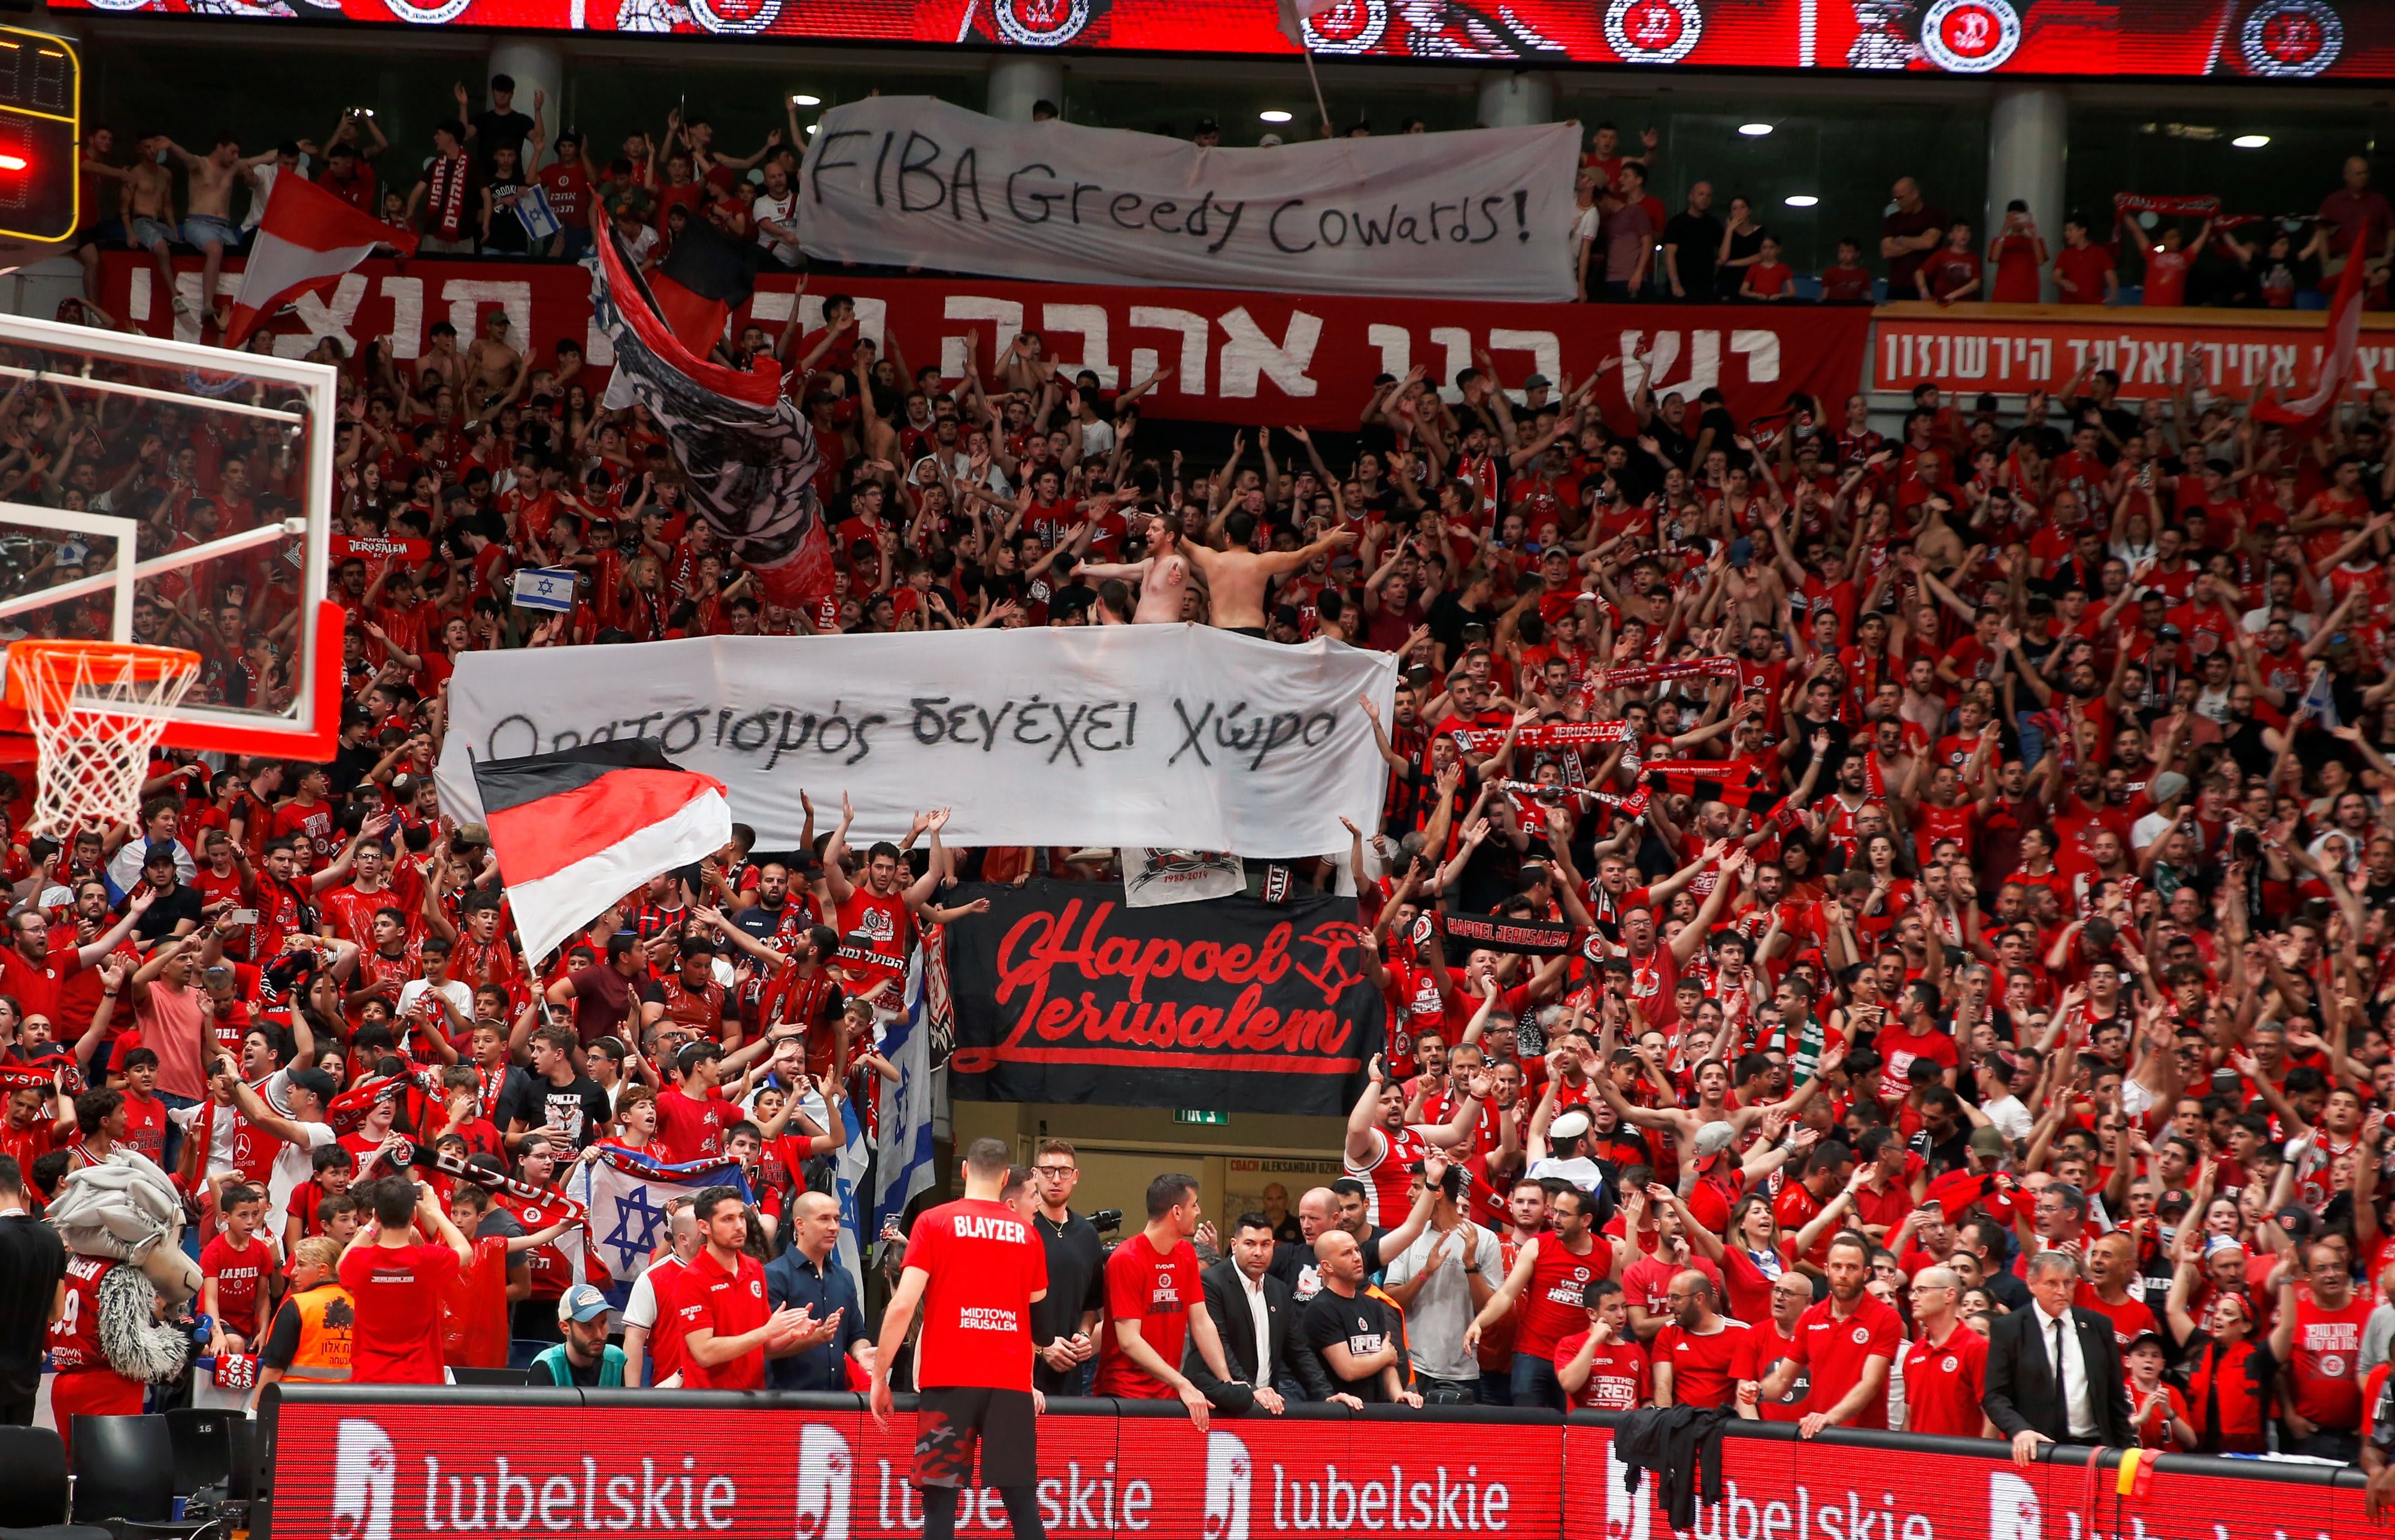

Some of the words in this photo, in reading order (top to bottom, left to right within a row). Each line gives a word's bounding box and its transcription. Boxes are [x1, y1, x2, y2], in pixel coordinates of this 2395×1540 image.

[813, 130, 989, 222] FIBA
[1006, 164, 1245, 253] Greedy
[1269, 190, 1529, 253] Cowards!
[941, 296, 1323, 398] אהבה
[1885, 334, 2053, 381] הירשנזון
[1620, 328, 1780, 412] יש
[349, 539, 408, 554] JERUSALEM
[1551, 725, 1625, 739] JERUSALEM
[1447, 918, 1494, 939] HAPOEL
[1496, 925, 1570, 948] JERUSALEM
[837, 947, 862, 960] נמצ
[865, 953, 905, 971] הפועל
[996, 898, 1292, 1006] Hapoel
[953, 971, 1359, 1073] Jerusalem
[547, 1093, 582, 1104] YALLA
[1230, 1160, 1260, 1172] COACH
[1261, 1160, 1317, 1174] ALEKSANDAR
[1319, 1163, 1344, 1175] DZIKI
[954, 1215, 1026, 1244] BLAYZER
[959, 1317, 1018, 1332] JERUSALEM
[960, 1306, 1017, 1321] MIDTOWN
[1350, 1335, 1381, 1353] HPOE
[242, 1359, 257, 1389] HAPO
[1592, 1375, 1636, 1386] TOGETHER
[1597, 1384, 1634, 1400] RED
[199, 1424, 212, 1433] 16
[426, 1456, 737, 1531] lubelskie
[877, 1459, 1155, 1532] lueskie
[1272, 1463, 1511, 1532] lubelskie
[1676, 1481, 1934, 1540] ubelskie
